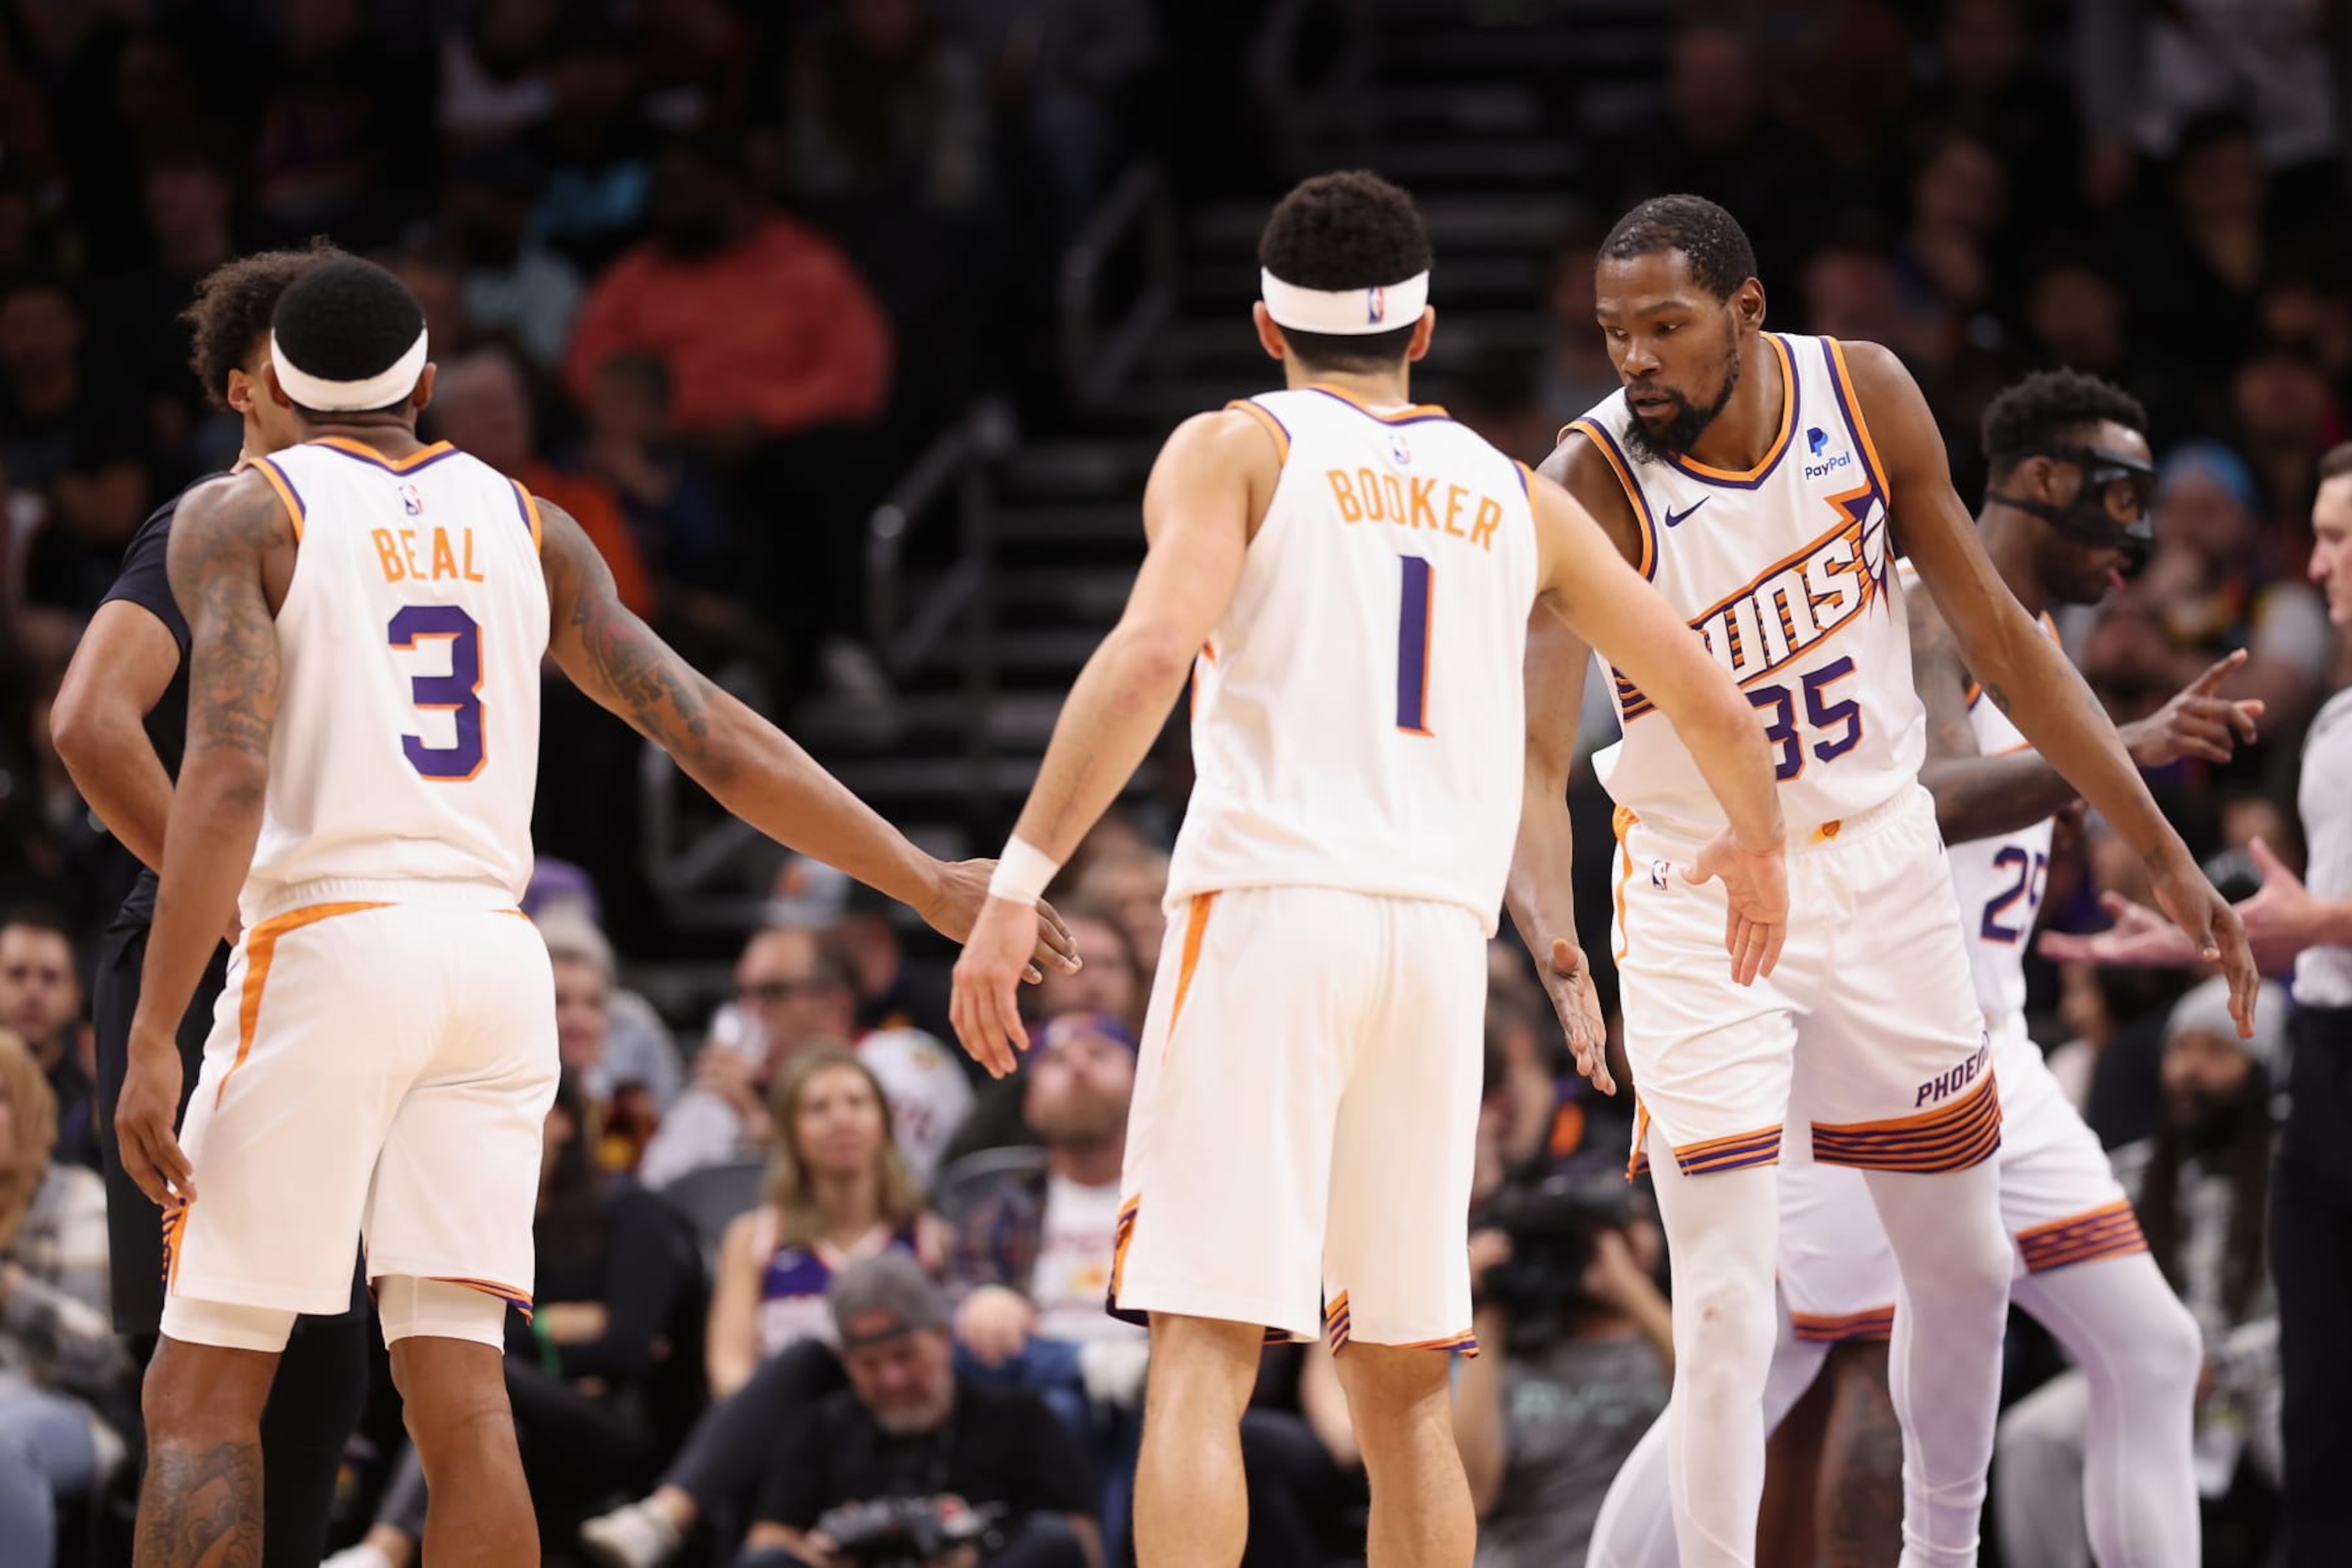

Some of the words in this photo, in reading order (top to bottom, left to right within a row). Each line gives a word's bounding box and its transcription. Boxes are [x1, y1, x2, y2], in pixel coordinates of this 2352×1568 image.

[1327, 467, 1504, 552] BOOKER
[1805, 451, 1850, 480] PayPal
[371, 527, 484, 582] BEAL
[1694, 535, 1861, 685] UNS
[388, 605, 488, 782] 3
[1396, 554, 1436, 737] 1
[1745, 655, 1863, 783] 35
